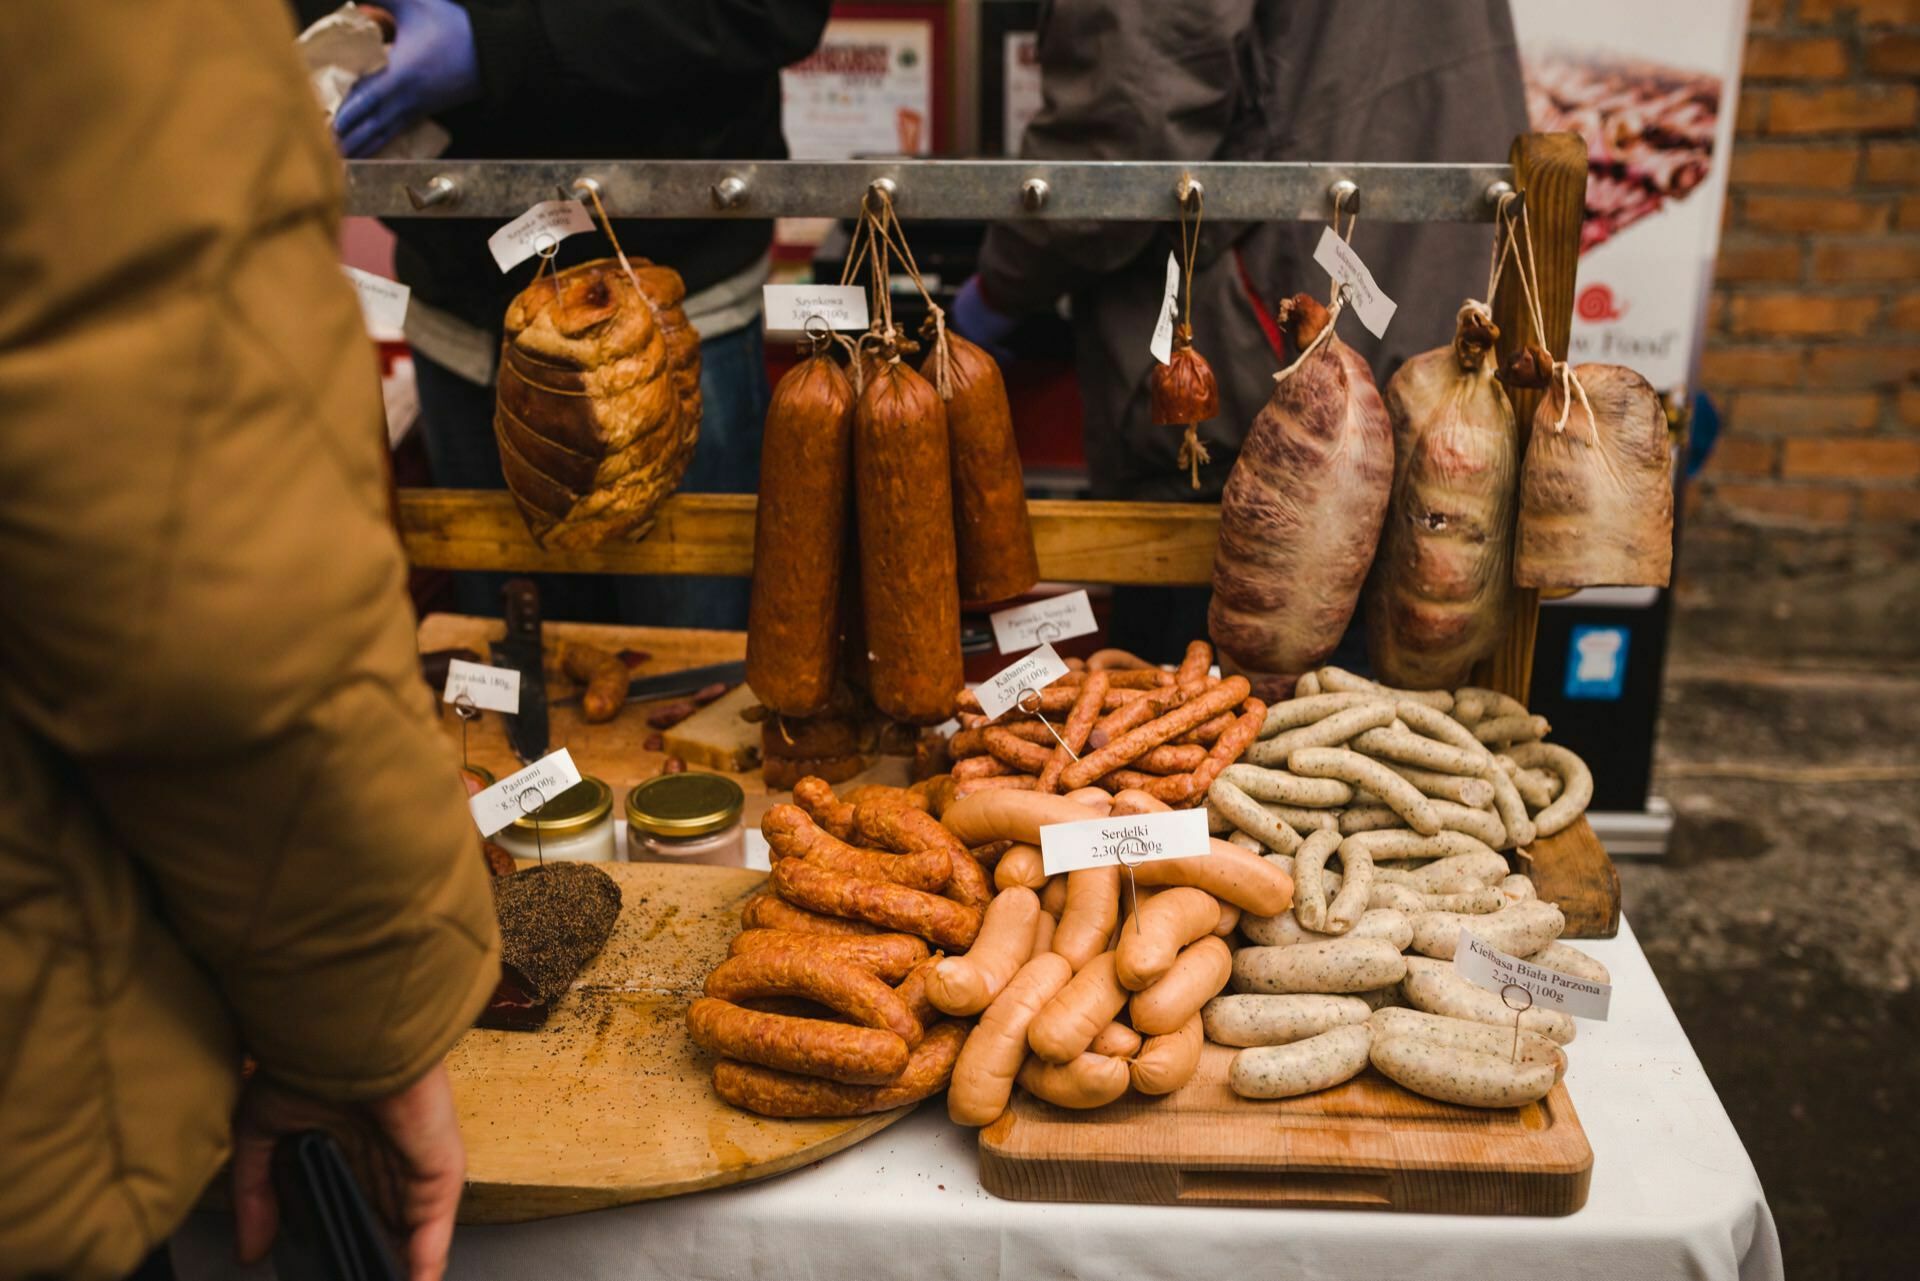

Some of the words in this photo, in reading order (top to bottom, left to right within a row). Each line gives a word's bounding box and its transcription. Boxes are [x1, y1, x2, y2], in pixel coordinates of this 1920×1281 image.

[795, 296, 843, 308] Szynkowa
[994, 659, 1037, 688] Kabanosy
[997, 686, 1016, 704] 5,20
[501, 766, 543, 795] Pastrami
[1101, 824, 1149, 840] Serdelki
[1091, 845, 1116, 858] 2,30
[1470, 940, 1513, 970] Kiełbasa
[1516, 963, 1547, 982] Biała
[1551, 974, 1600, 995] Parzona
[1492, 969, 1517, 986] 2,20
